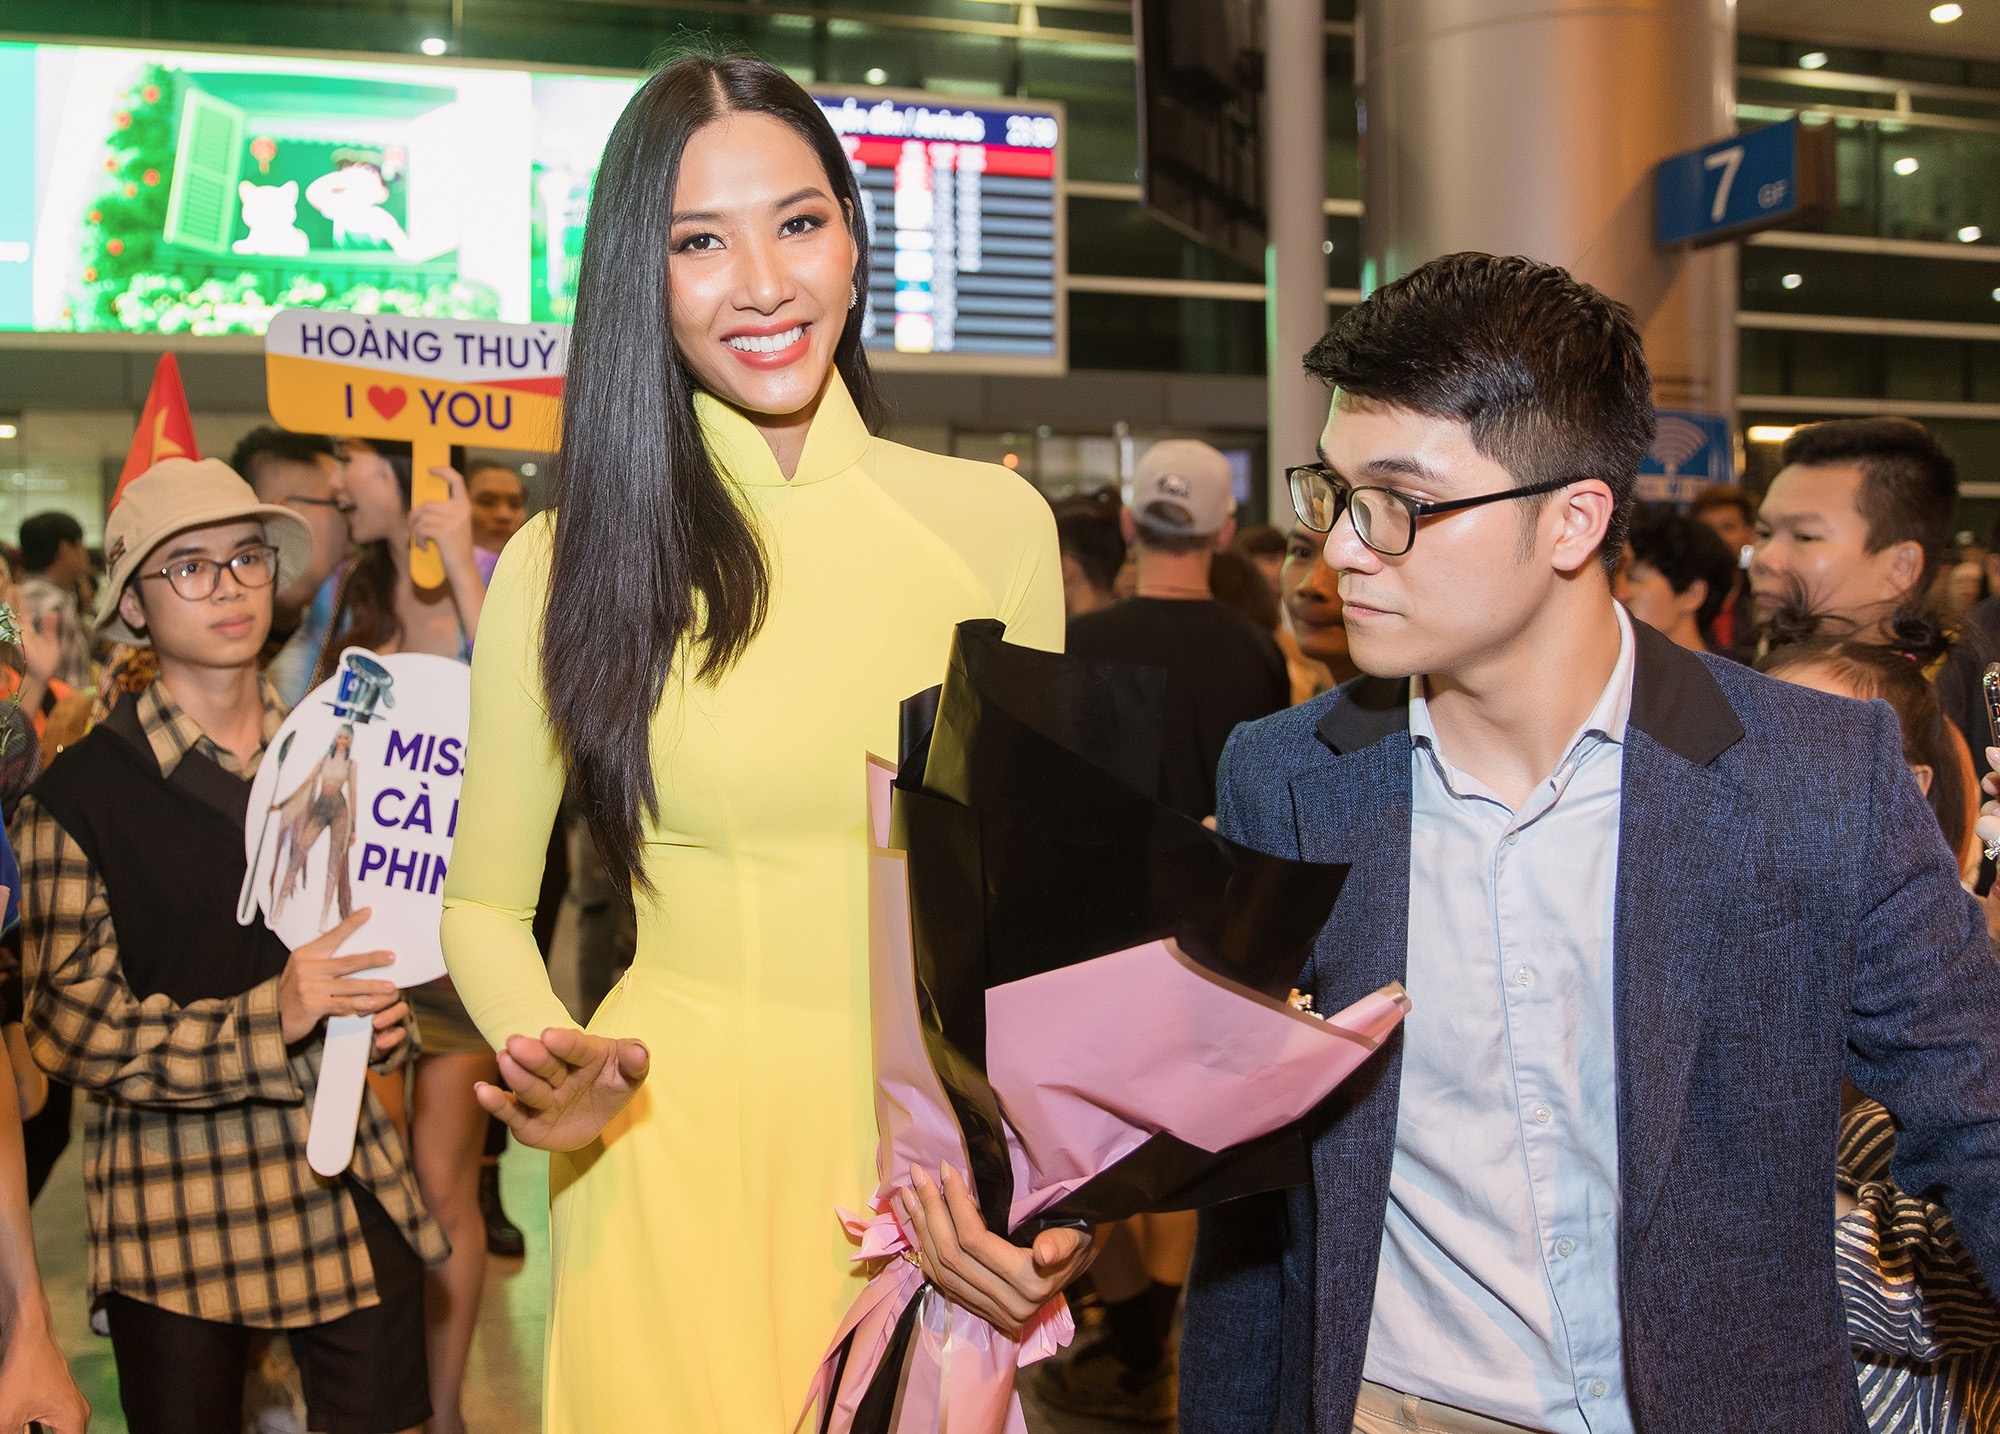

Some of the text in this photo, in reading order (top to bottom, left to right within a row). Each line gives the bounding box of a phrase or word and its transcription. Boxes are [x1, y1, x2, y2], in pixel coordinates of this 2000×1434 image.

[1704, 145, 1745, 223] 7
[301, 317, 557, 370] HOÀNG THUỲ
[420, 389, 512, 431] YOU
[383, 729, 467, 778] MIS
[372, 781, 434, 835] CÀ
